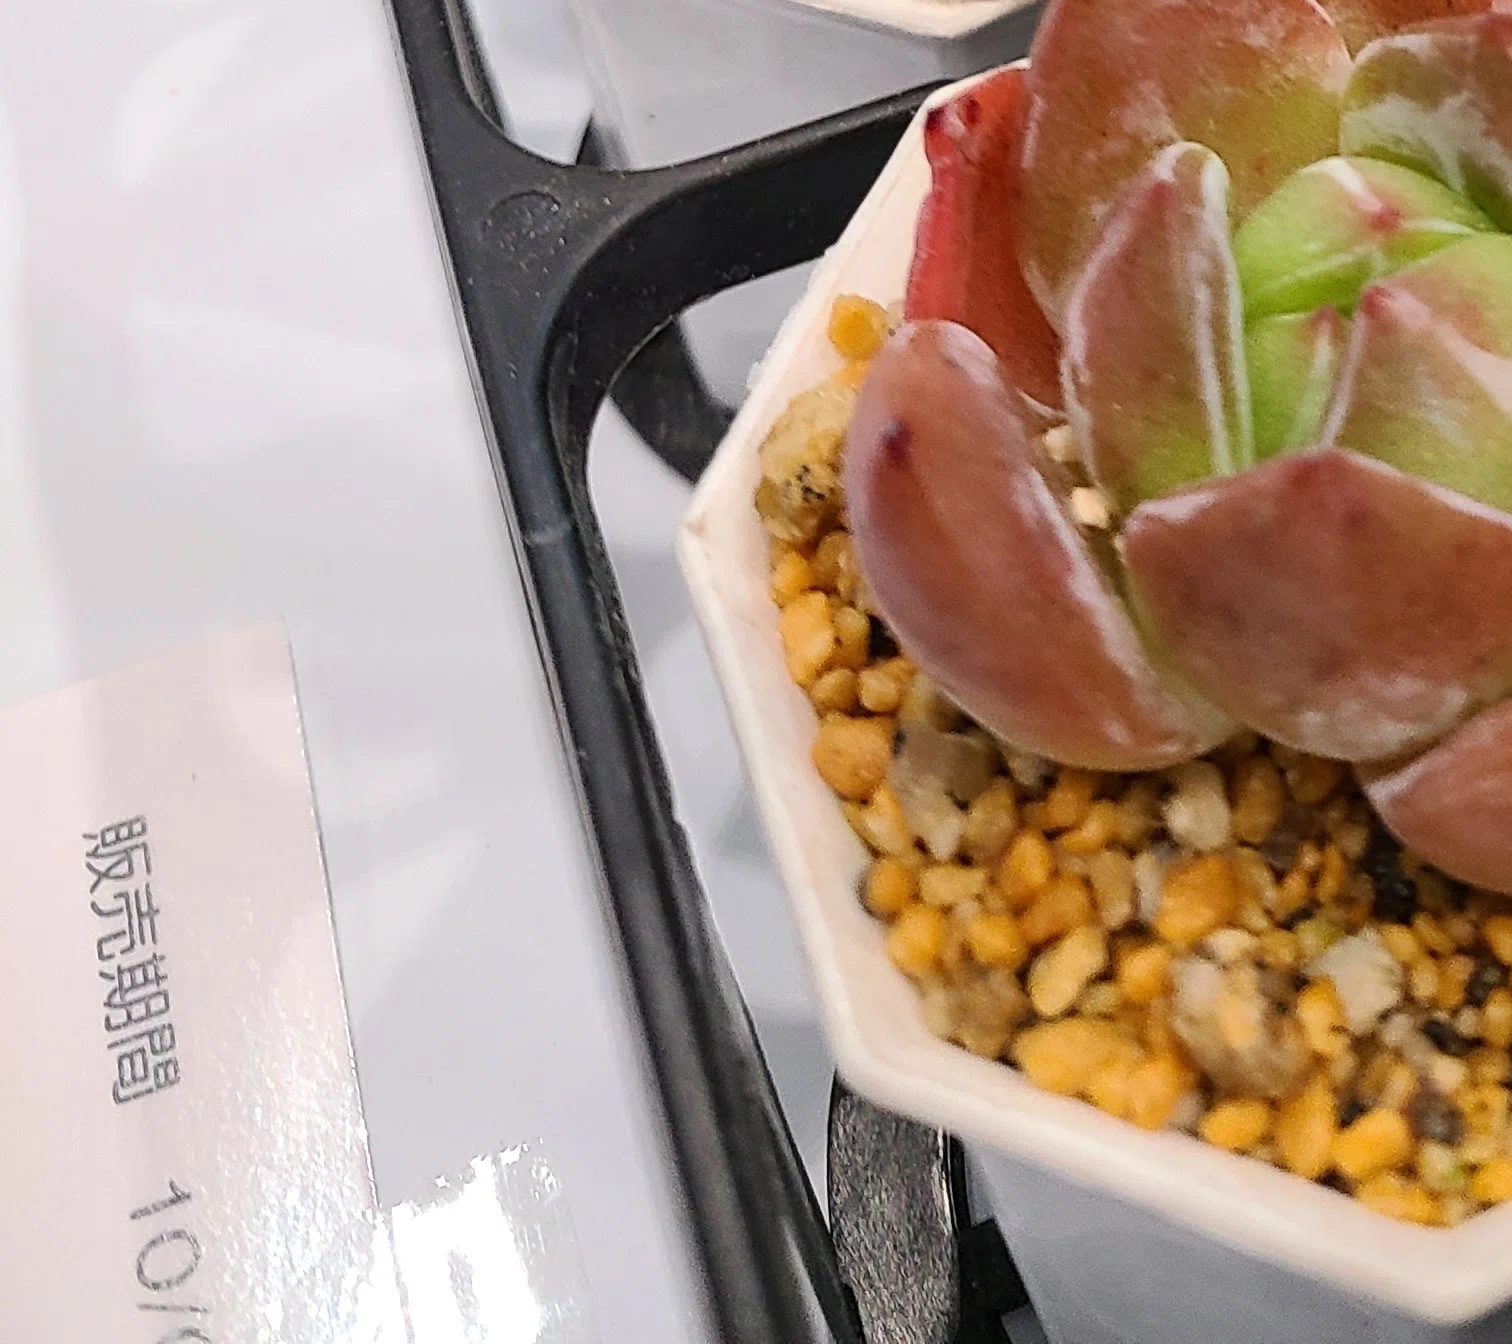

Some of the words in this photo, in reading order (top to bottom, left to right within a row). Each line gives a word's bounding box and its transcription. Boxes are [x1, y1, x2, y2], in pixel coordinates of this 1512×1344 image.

[82, 814, 182, 1105] 販売期間
[130, 1178, 212, 1344] 10/
